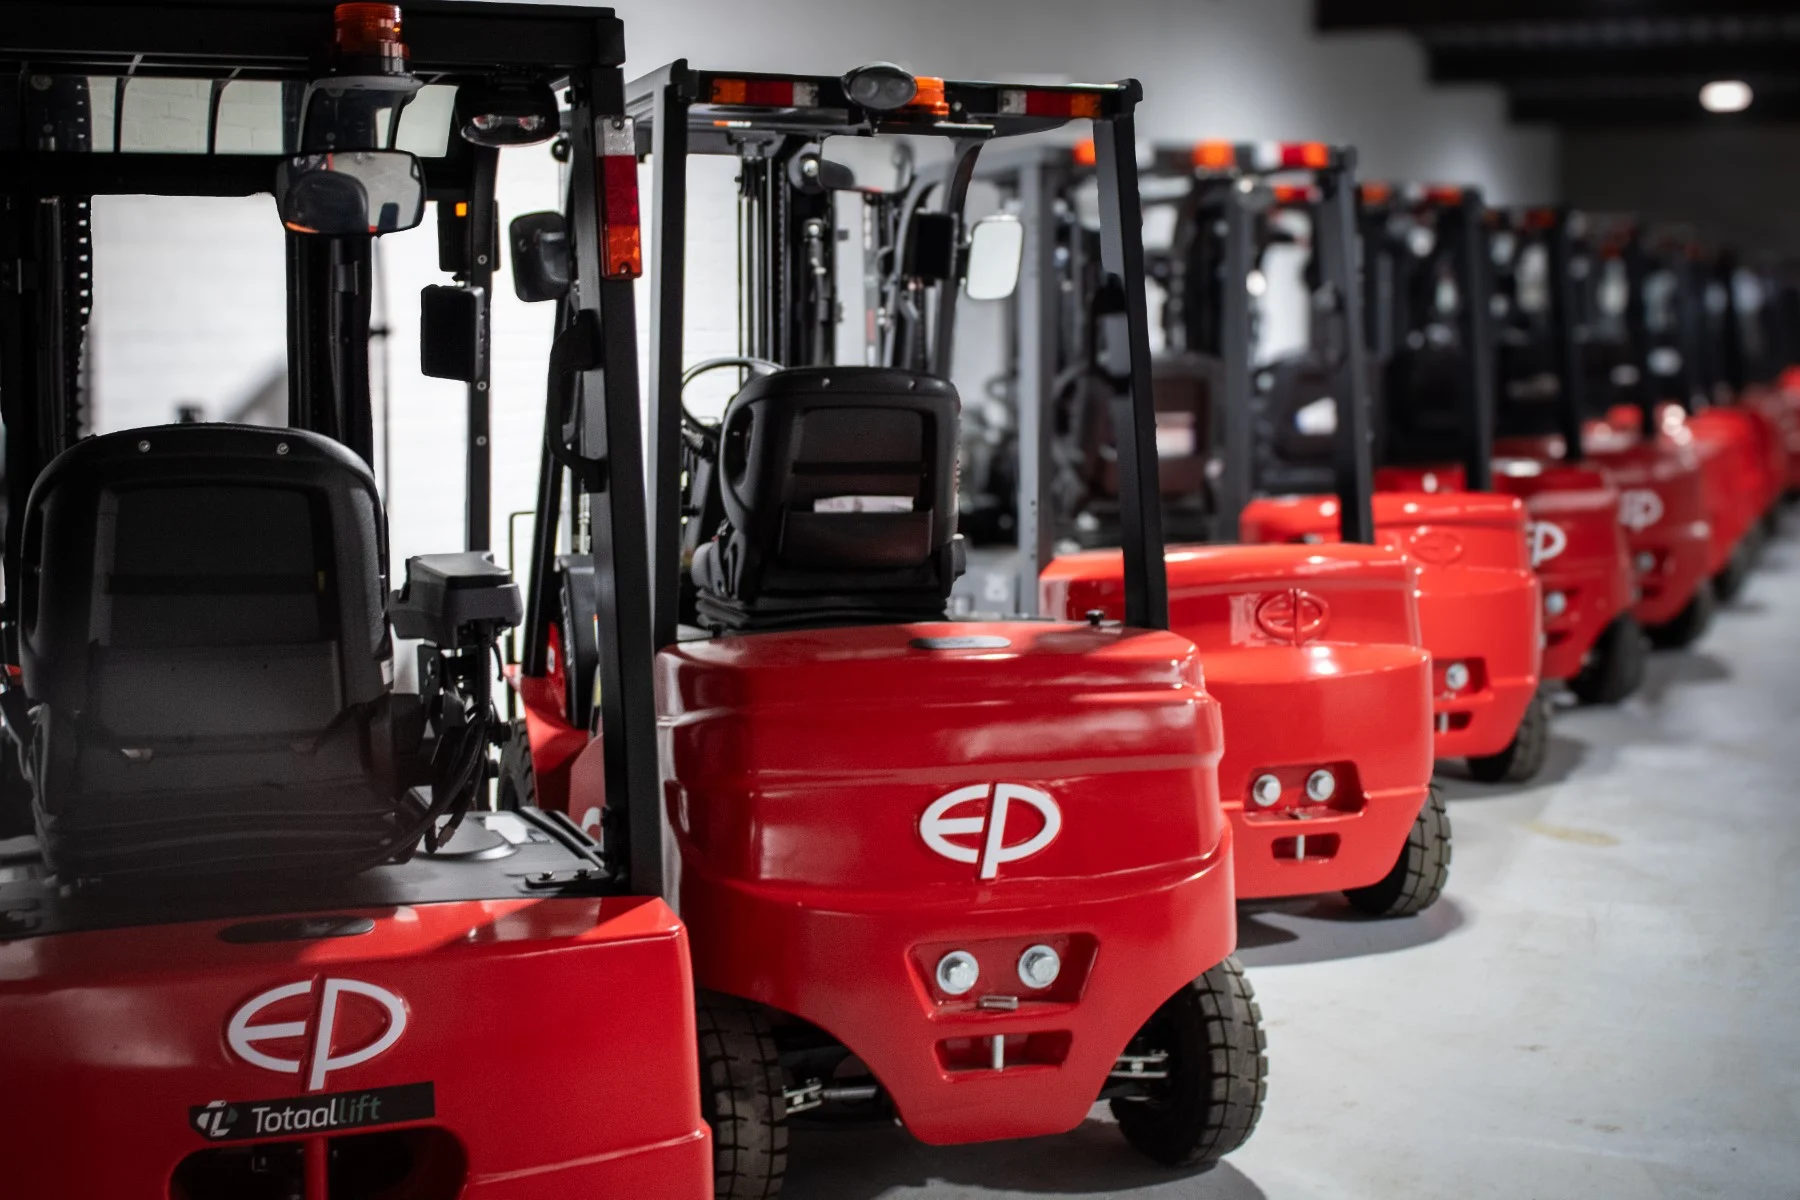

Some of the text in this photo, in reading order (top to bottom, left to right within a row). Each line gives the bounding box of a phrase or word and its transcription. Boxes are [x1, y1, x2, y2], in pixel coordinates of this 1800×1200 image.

[1526, 520, 1567, 567] P
[919, 783, 1061, 879] EP
[228, 978, 407, 1091] EP
[252, 1095, 382, 1133] Totaallift
